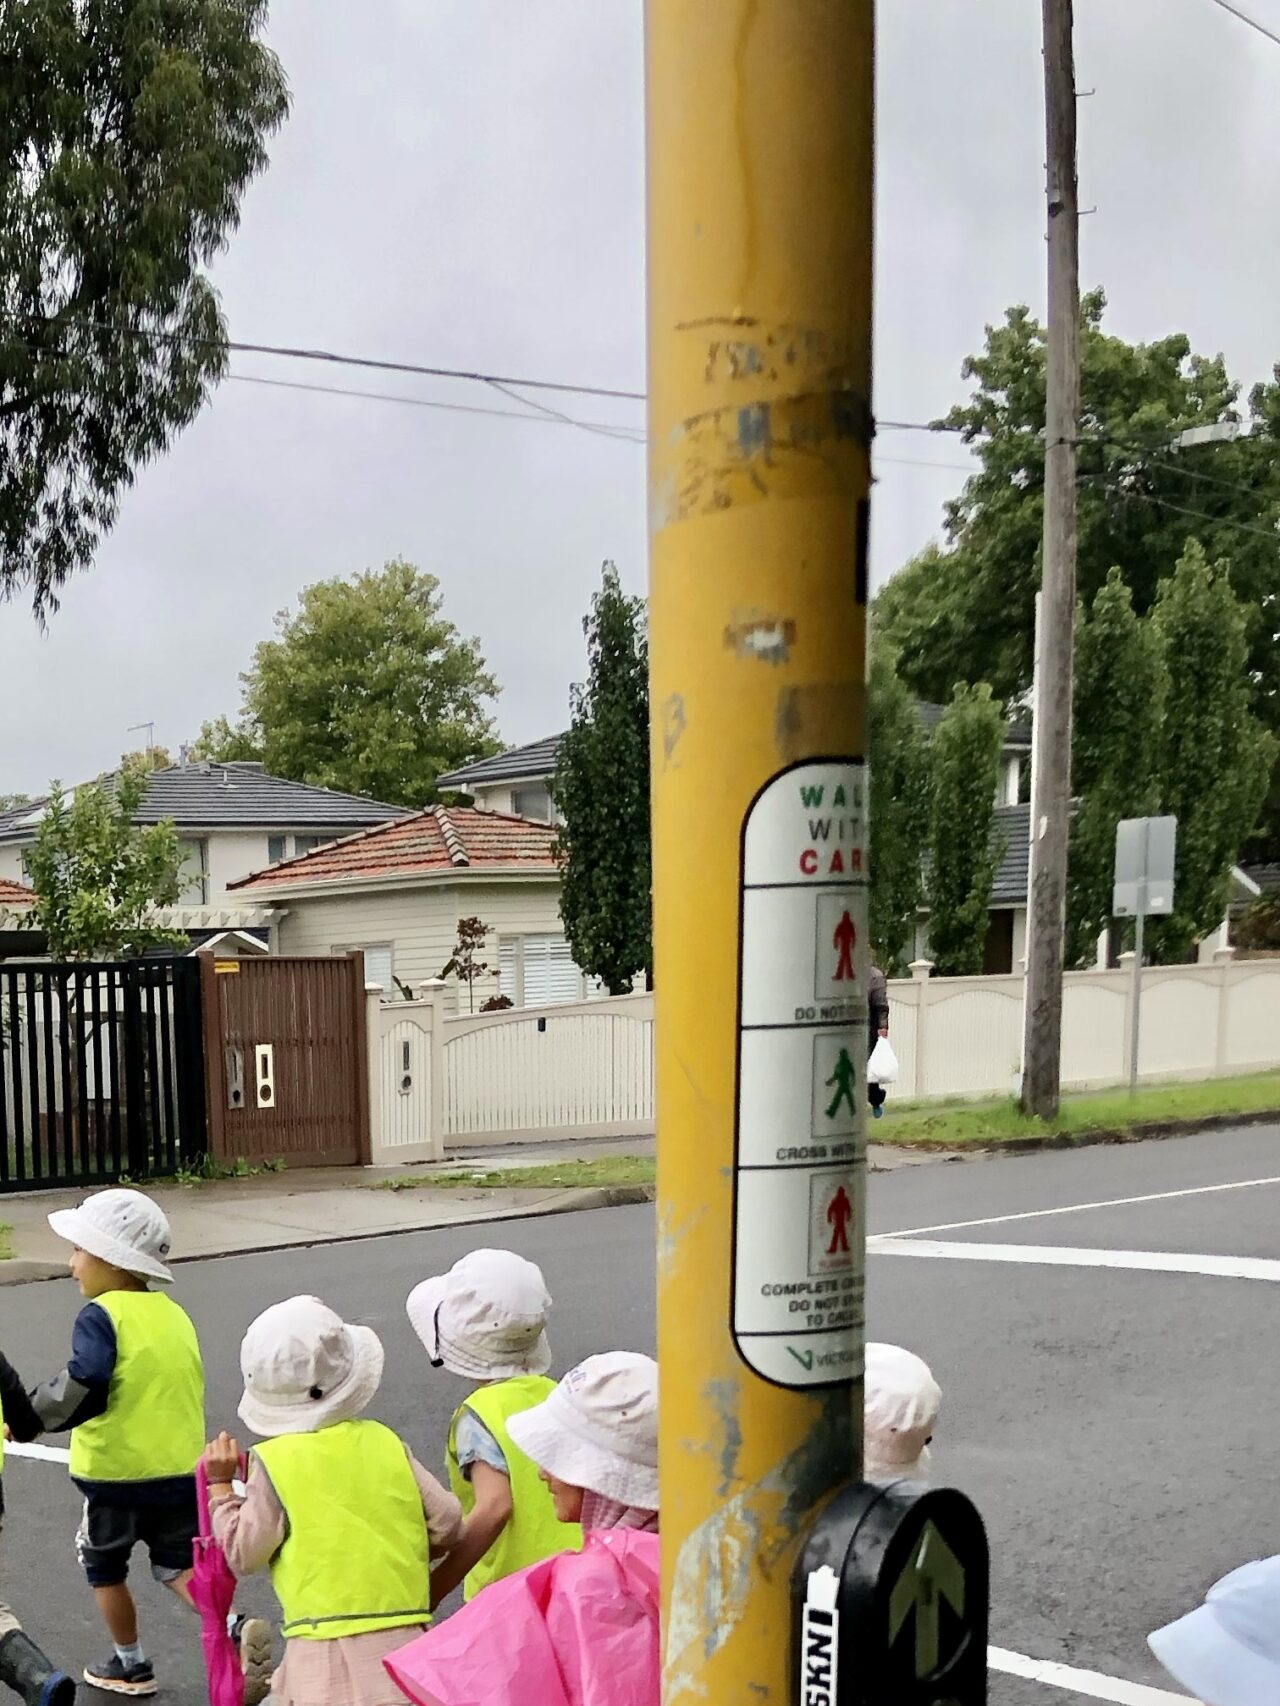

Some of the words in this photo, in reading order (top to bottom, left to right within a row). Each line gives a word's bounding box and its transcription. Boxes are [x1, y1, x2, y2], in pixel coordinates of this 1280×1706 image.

[799, 784, 862, 808] WAL
[808, 818, 863, 841] WIT
[799, 849, 863, 875] CAR
[795, 1007, 815, 1020] DO
[776, 1146, 827, 1161] CROSS
[761, 1279, 837, 1296] COMPLETE
[788, 1300, 810, 1312] DO
